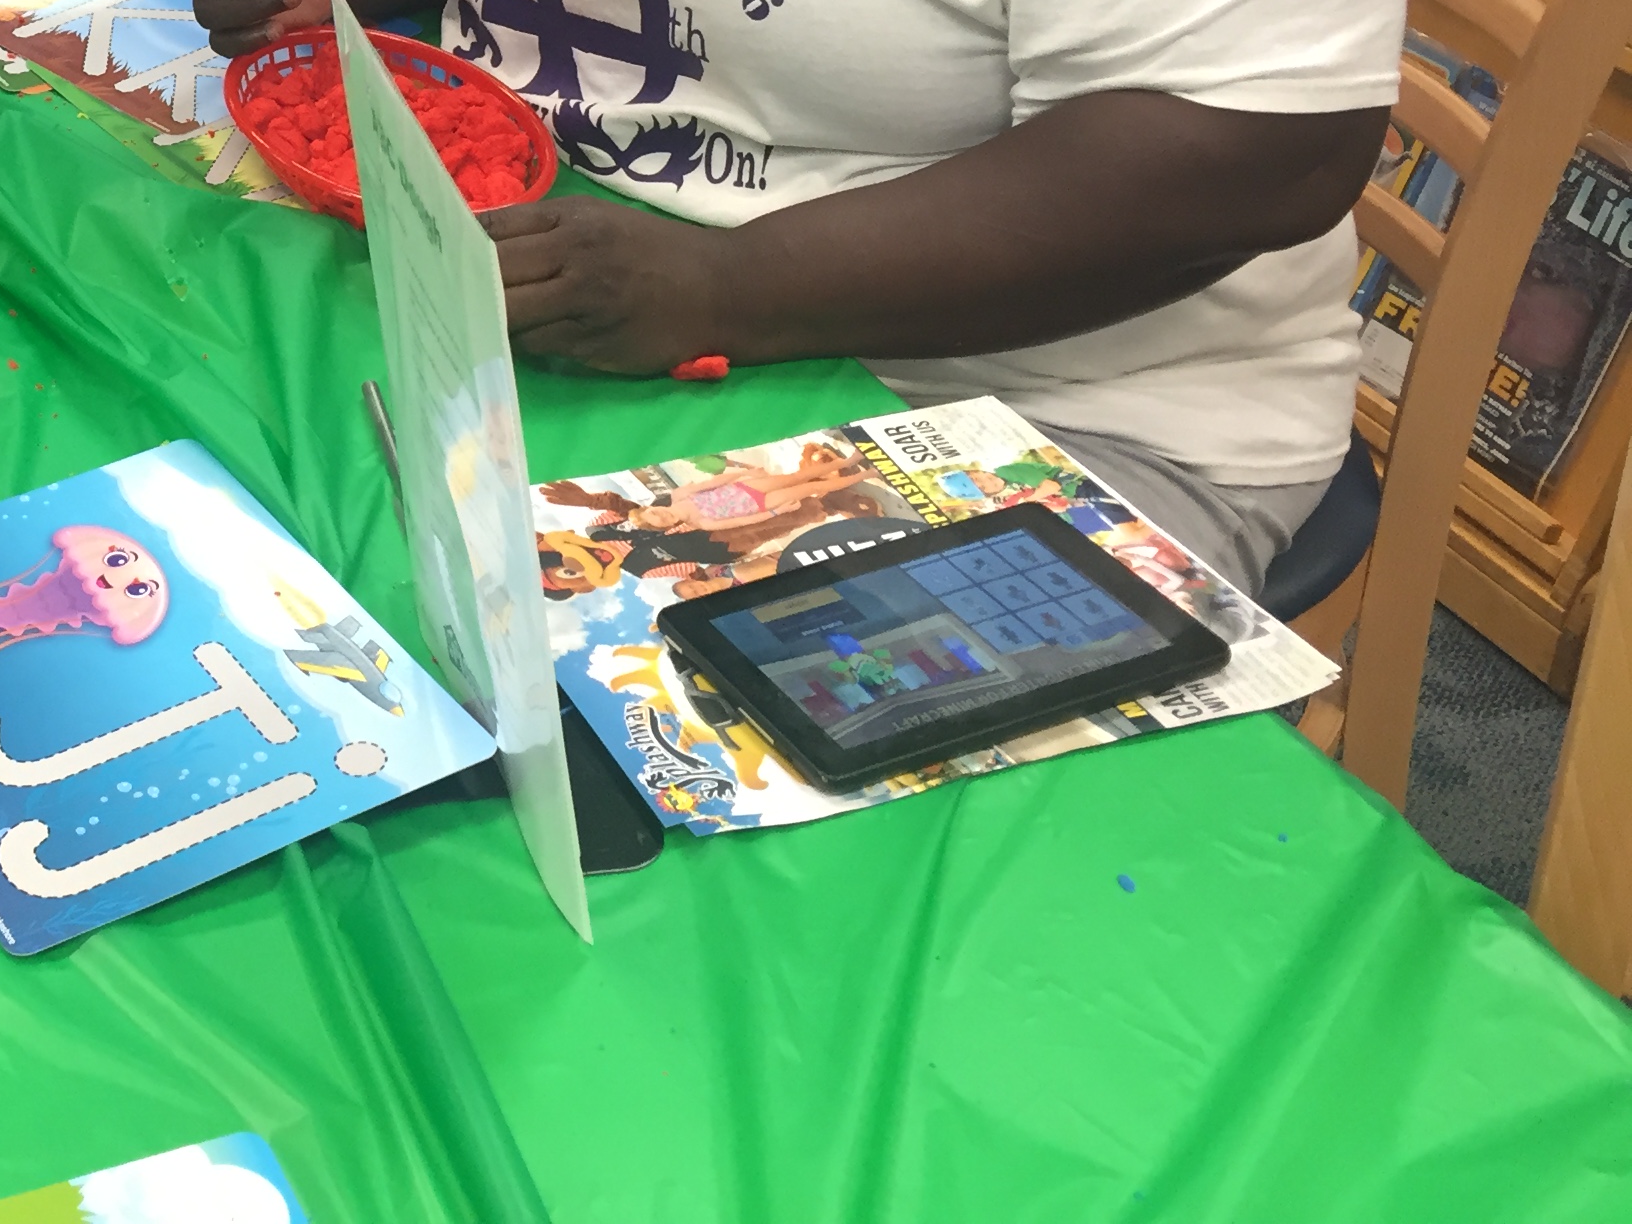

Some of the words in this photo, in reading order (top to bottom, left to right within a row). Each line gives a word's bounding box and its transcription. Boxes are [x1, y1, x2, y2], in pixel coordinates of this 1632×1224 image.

[704, 132, 775, 191] On!
[911, 420, 937, 434] US
[884, 425, 938, 463] SOAR
[925, 434, 962, 460] WITH
